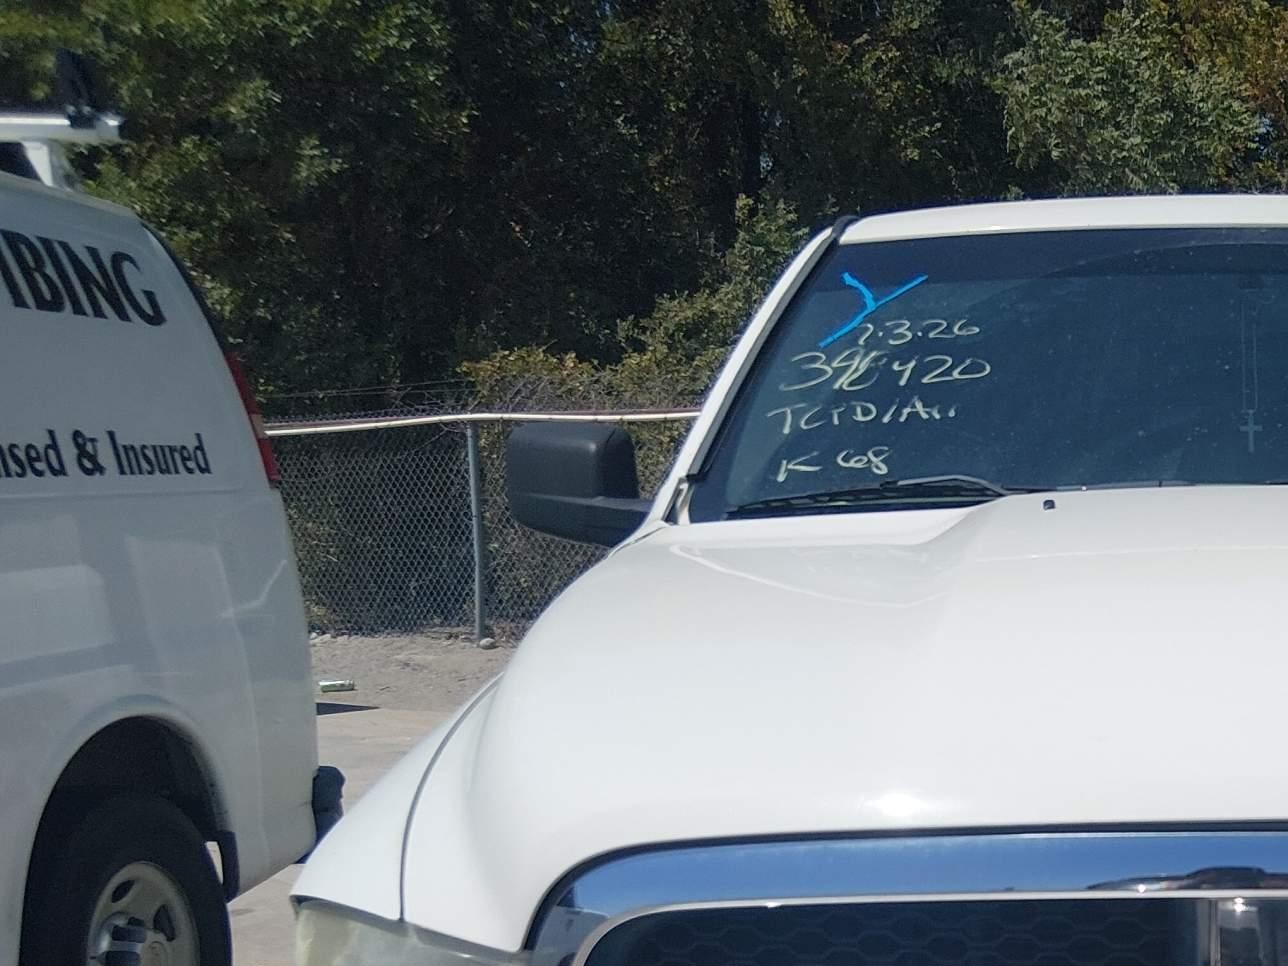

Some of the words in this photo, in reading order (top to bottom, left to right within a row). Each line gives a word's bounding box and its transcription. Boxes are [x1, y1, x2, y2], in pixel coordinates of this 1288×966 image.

[0, 226, 167, 326] BING
[71, 429, 107, 476] &
[106, 430, 214, 476] Insured
